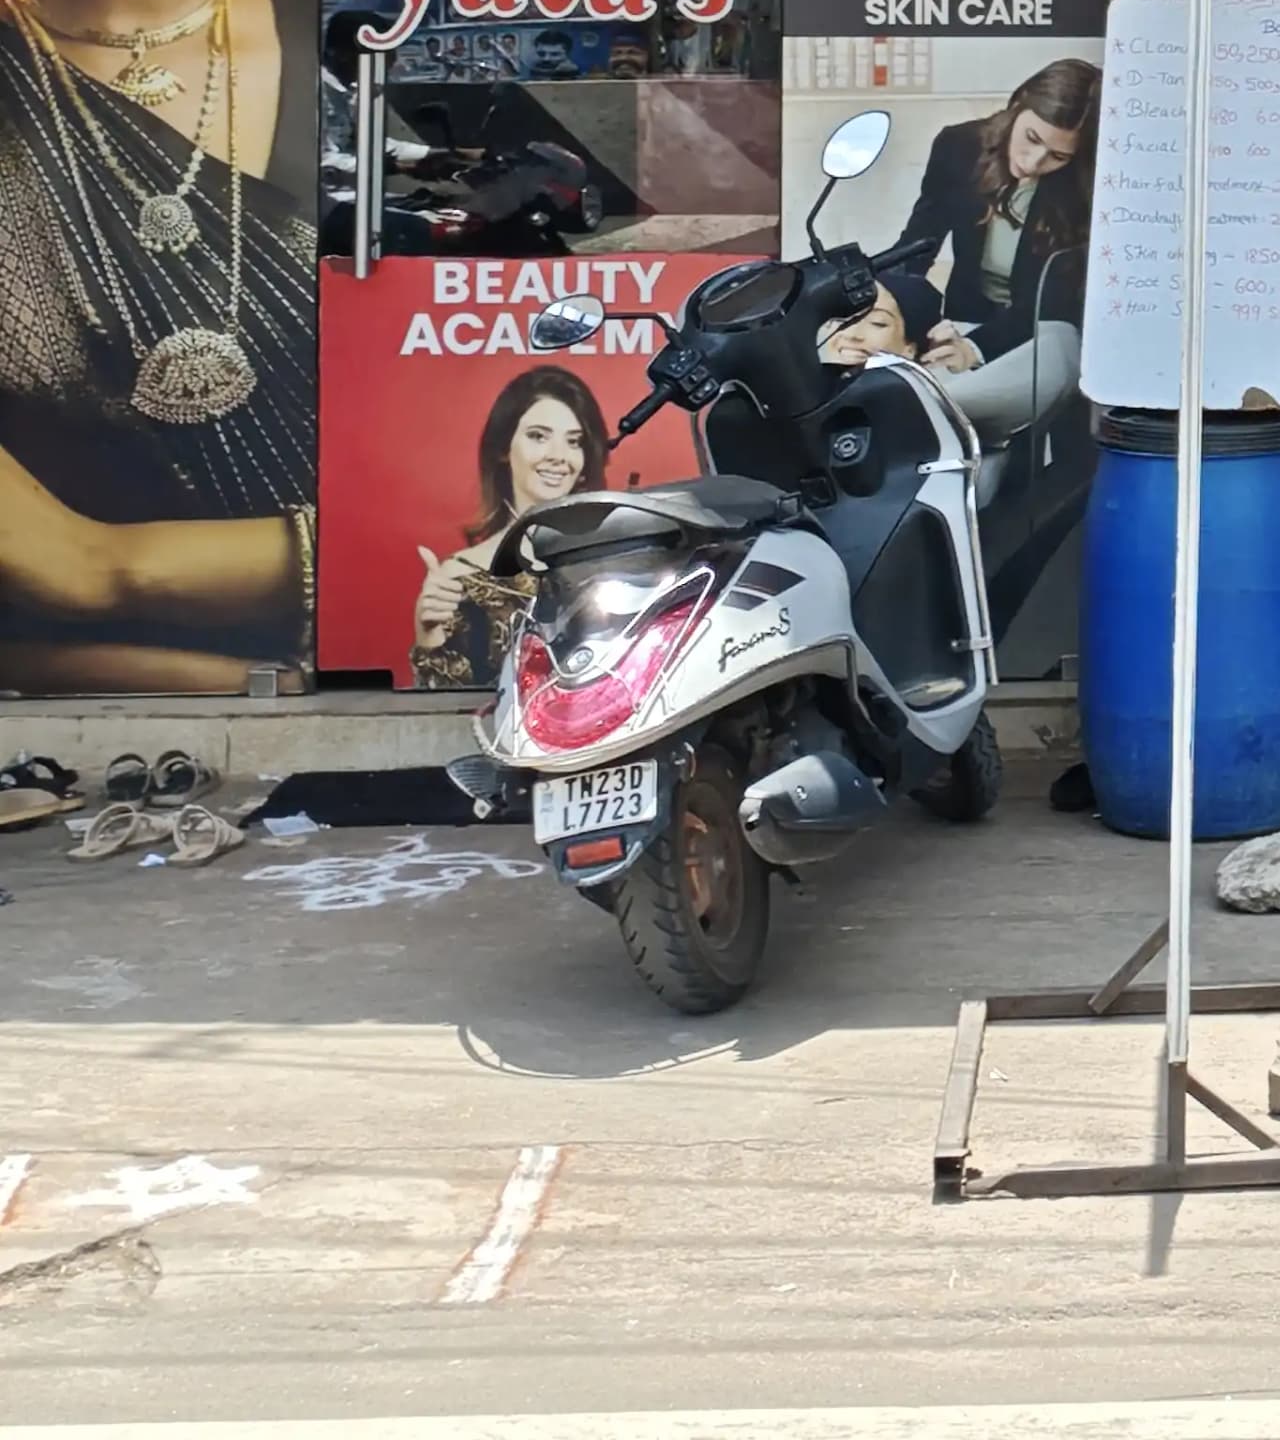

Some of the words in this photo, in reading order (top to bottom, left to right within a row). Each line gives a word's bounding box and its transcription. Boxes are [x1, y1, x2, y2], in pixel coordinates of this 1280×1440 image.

[433, 262, 667, 305] BEAUTY
[564, 765, 644, 803] TN23D
[562, 794, 643, 832] L7723
